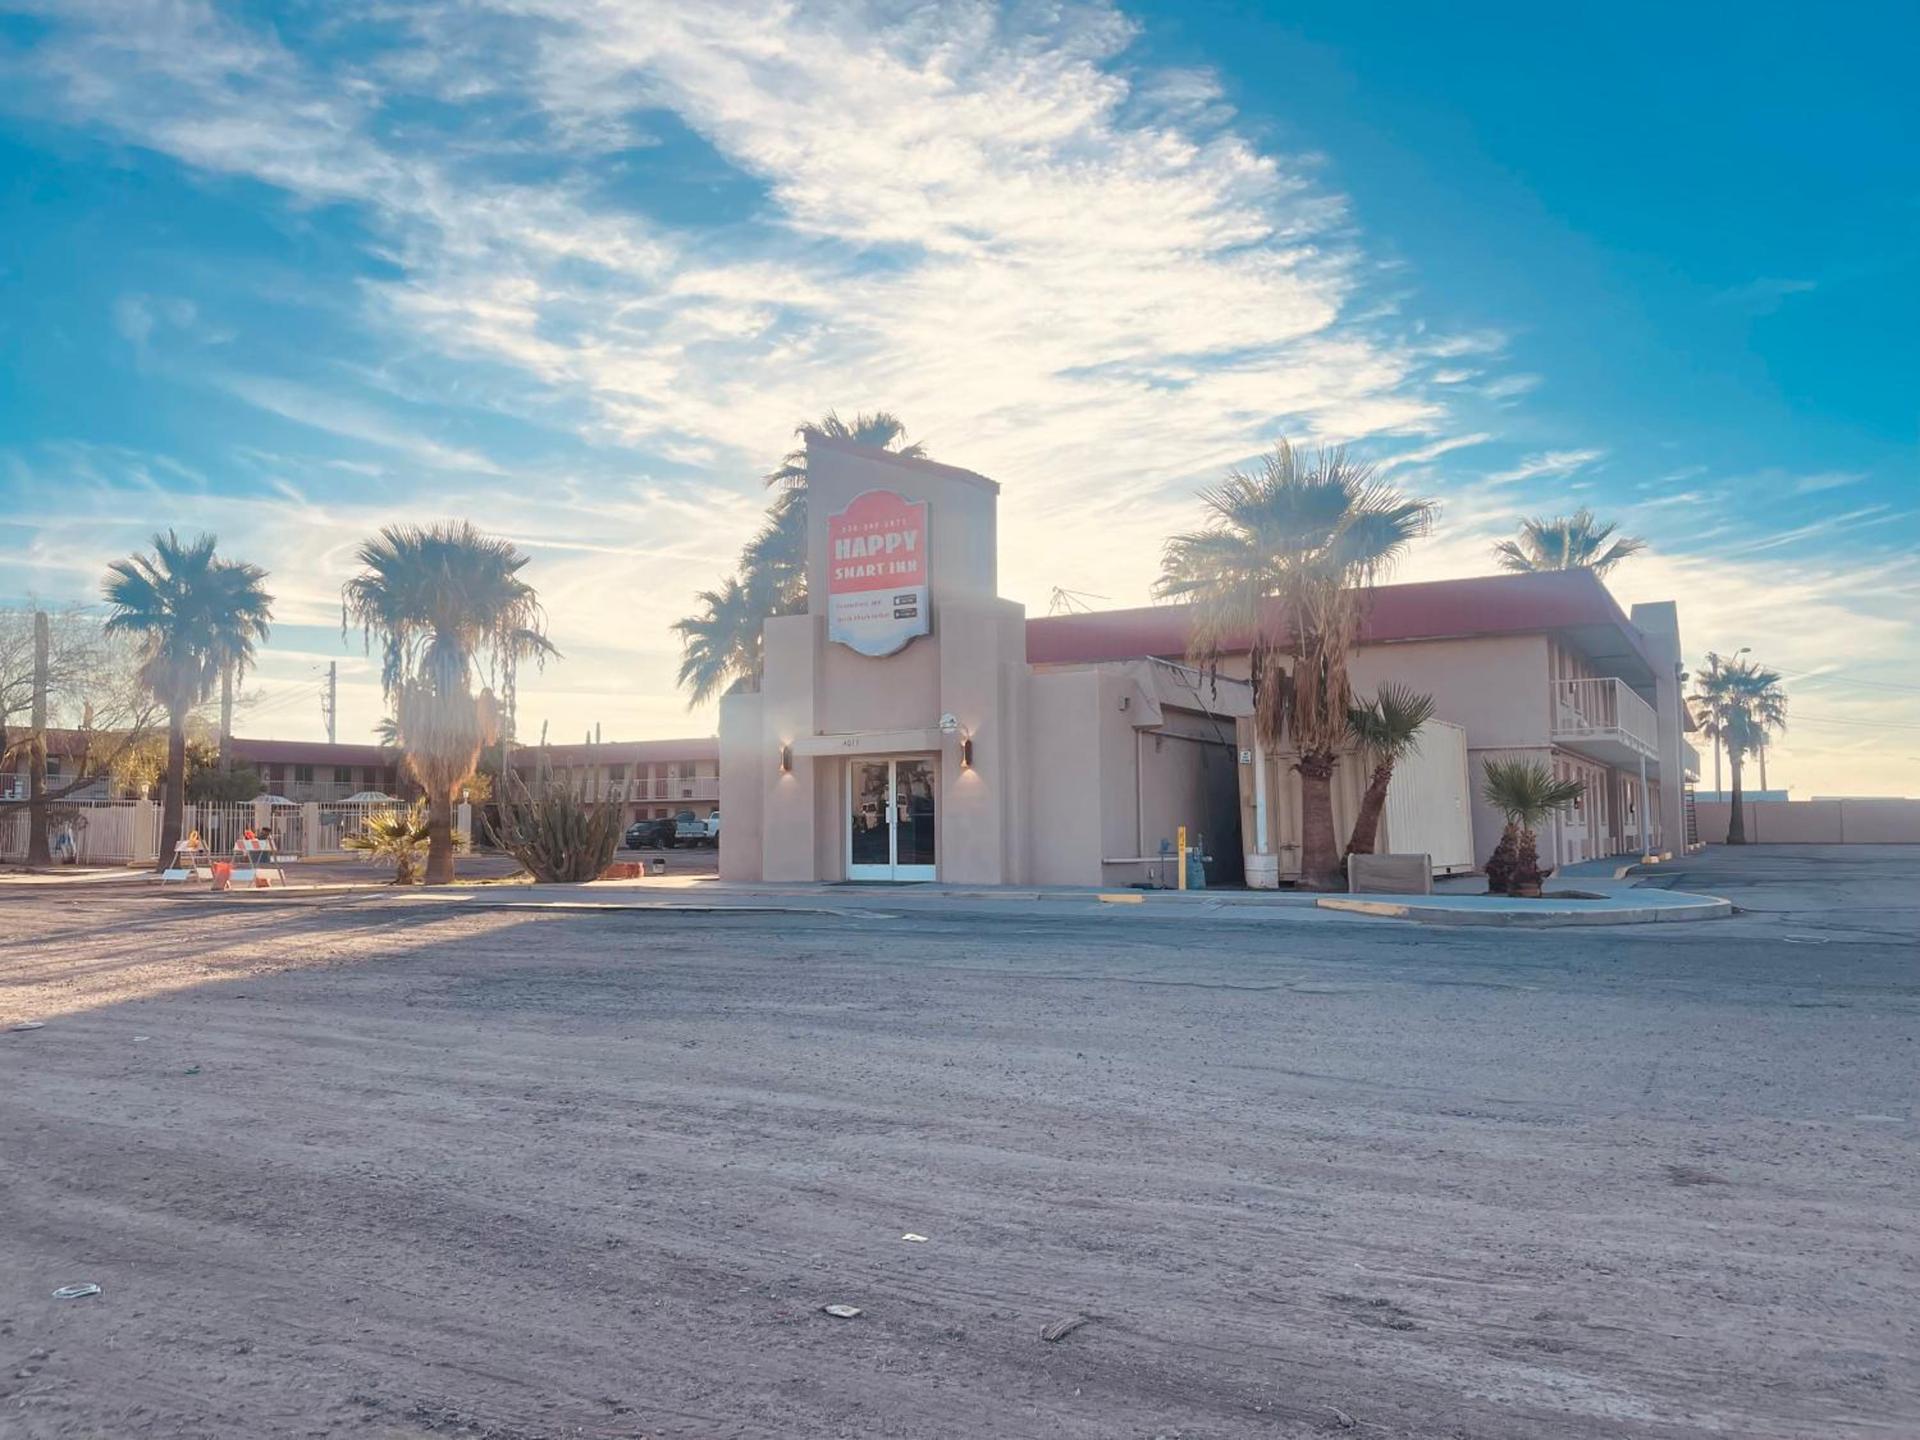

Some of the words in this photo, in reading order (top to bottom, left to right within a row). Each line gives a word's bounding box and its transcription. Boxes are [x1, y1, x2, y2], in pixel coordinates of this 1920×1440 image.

[835, 529, 918, 560] HAPPY
[834, 563, 886, 580] SMART
[889, 559, 917, 574] INN
